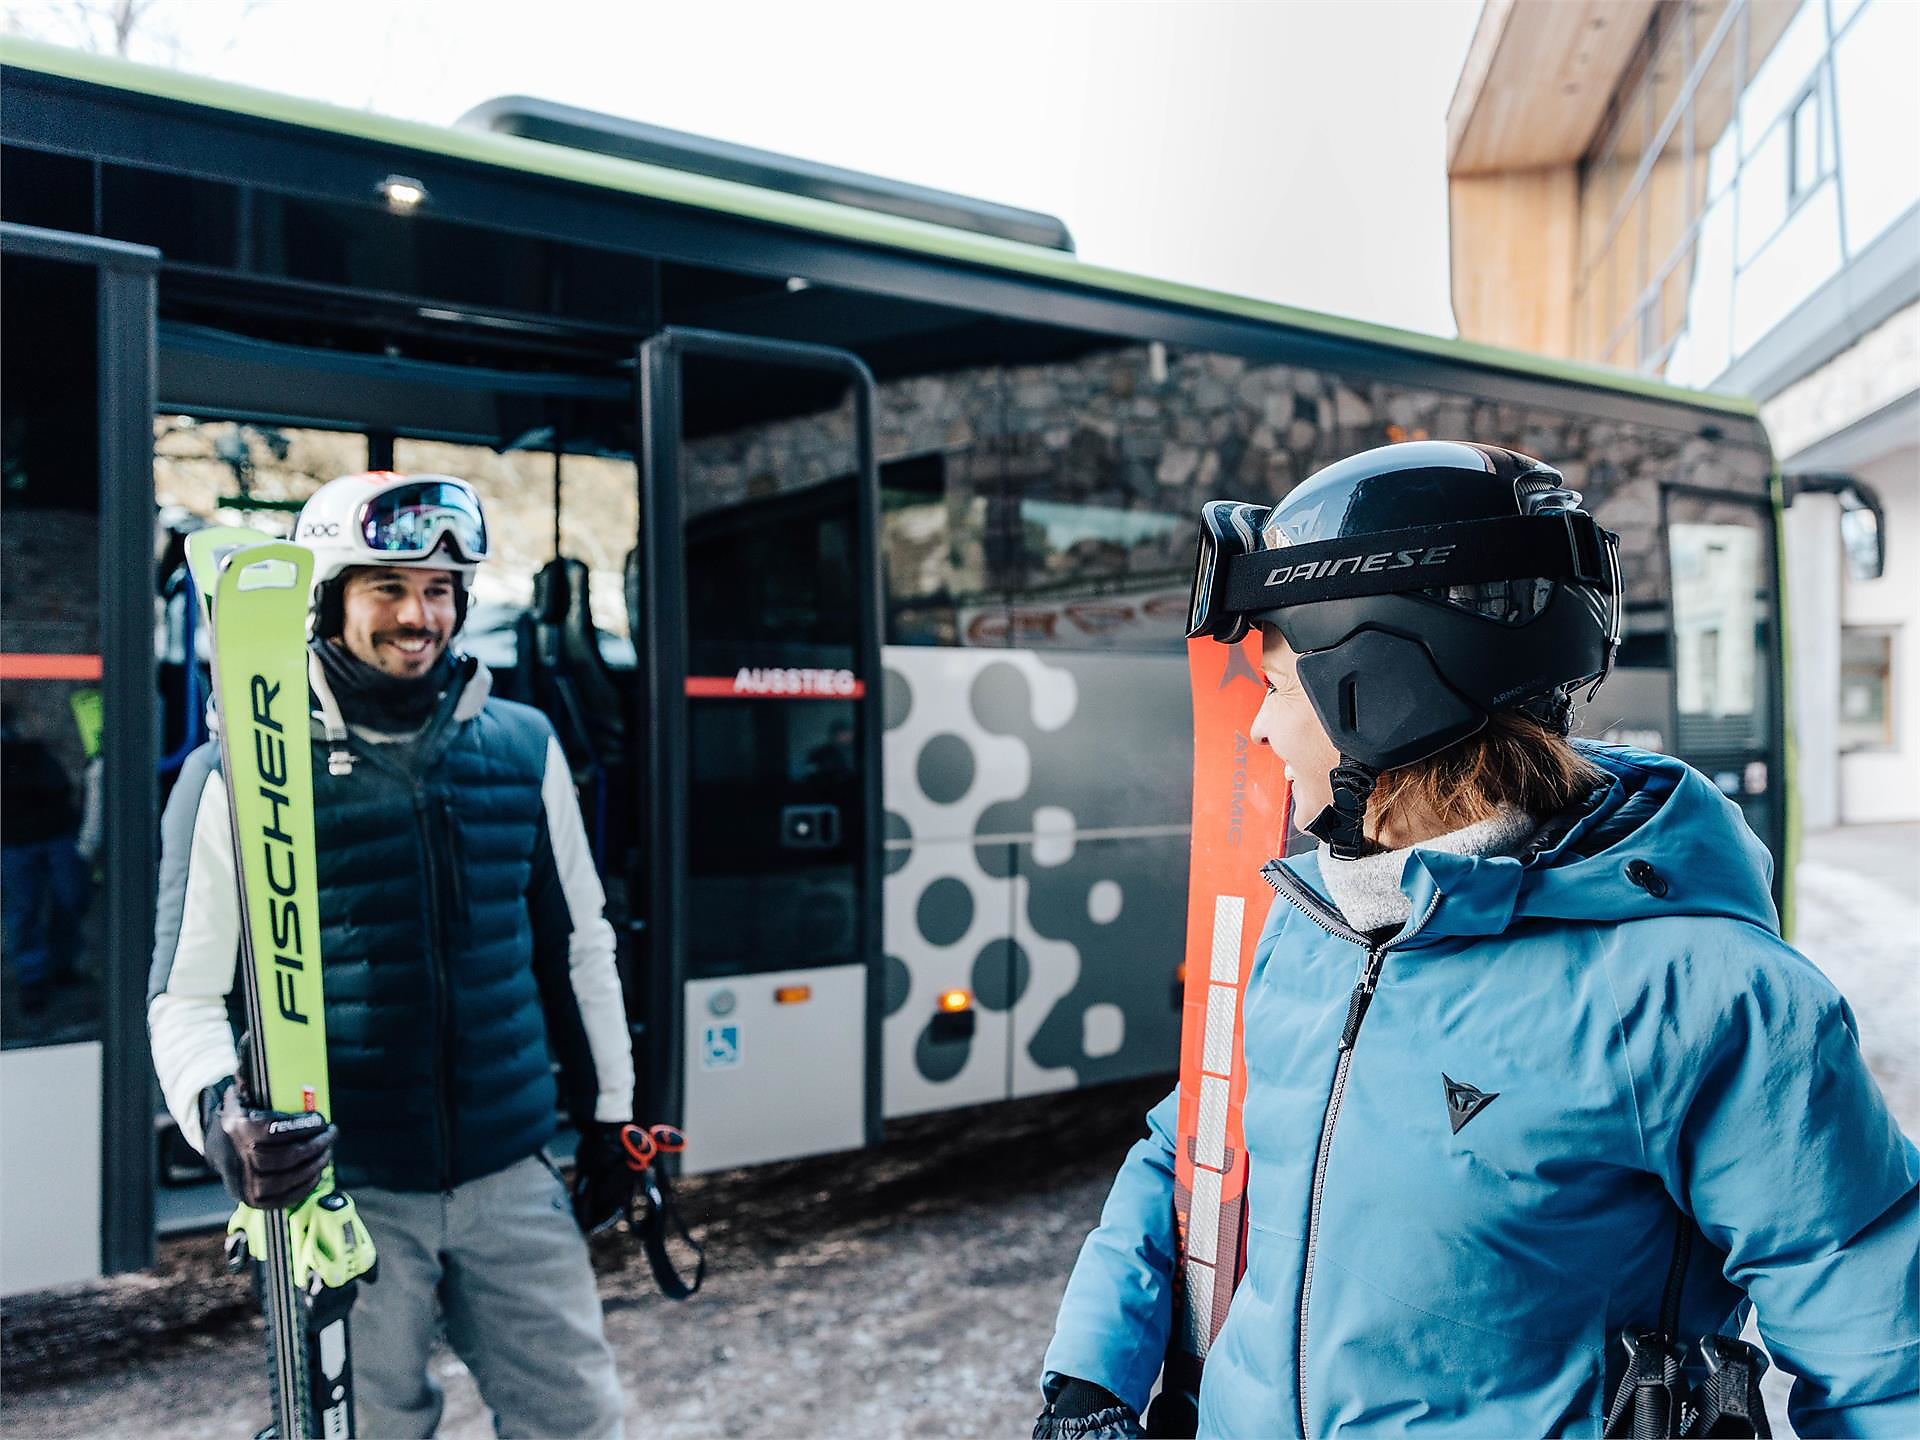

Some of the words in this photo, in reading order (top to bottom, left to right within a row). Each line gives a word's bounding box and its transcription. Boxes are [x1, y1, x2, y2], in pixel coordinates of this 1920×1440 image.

[1264, 544, 1456, 587] DAINESE
[734, 666, 855, 695] AUSSTIEG
[1227, 729, 1249, 848] ATOMIC
[251, 673, 309, 1025] FISCHER
